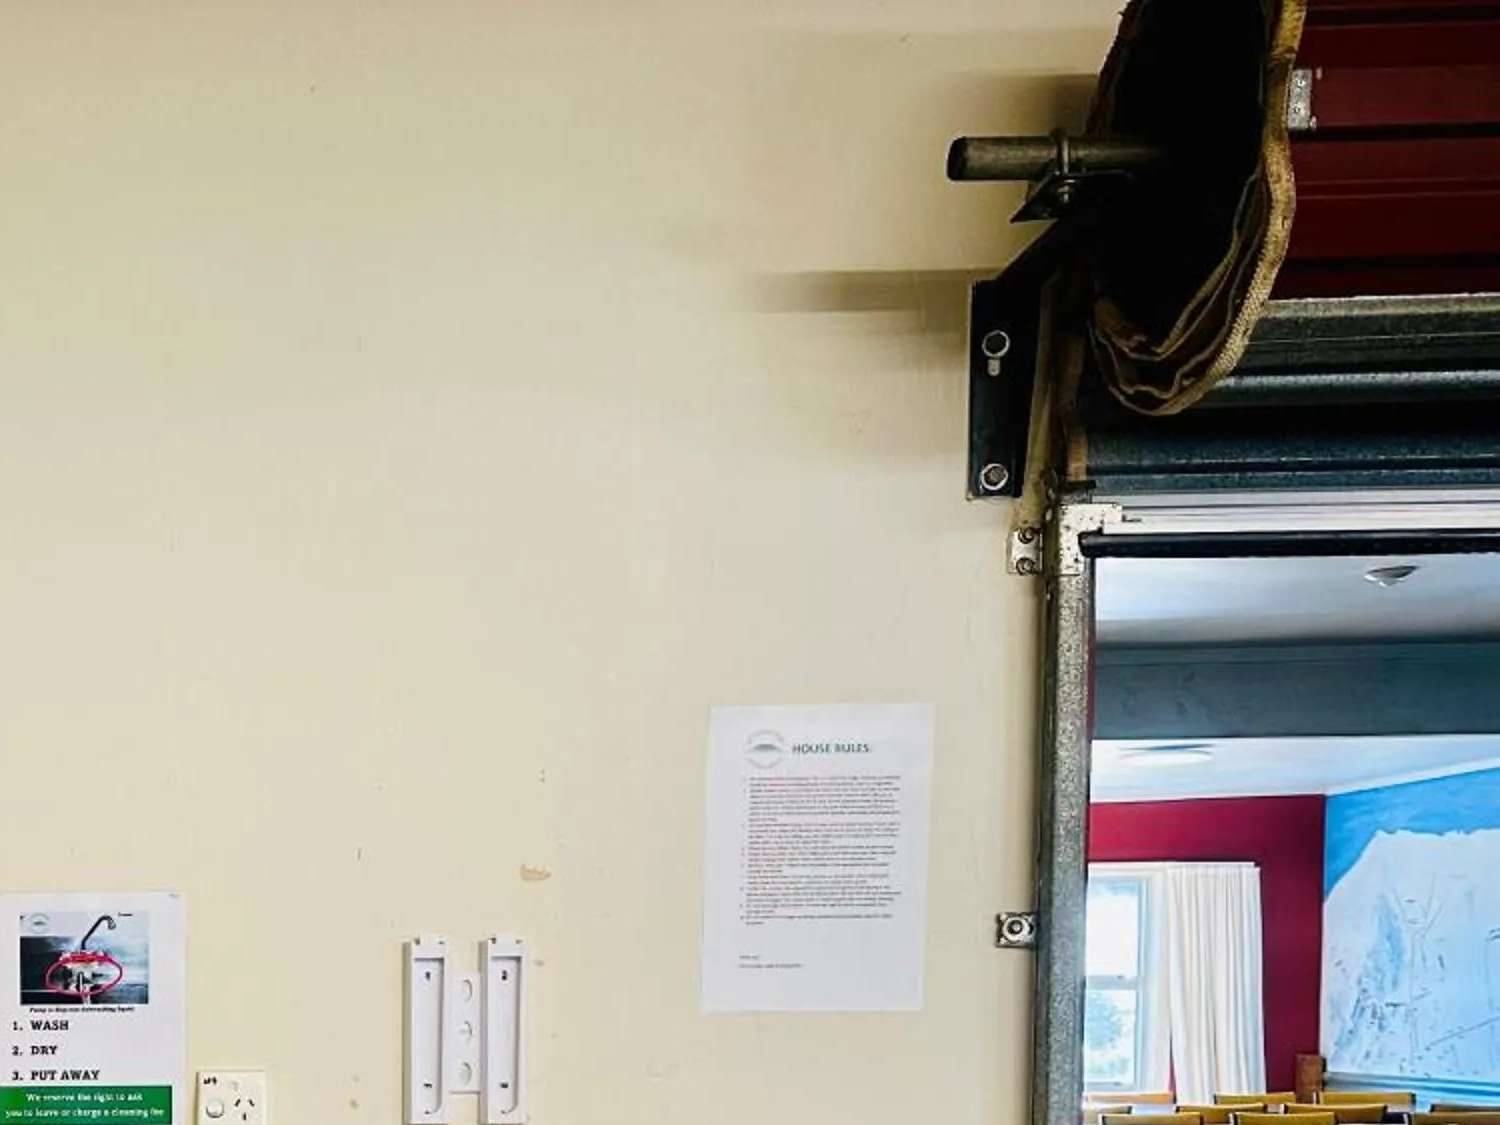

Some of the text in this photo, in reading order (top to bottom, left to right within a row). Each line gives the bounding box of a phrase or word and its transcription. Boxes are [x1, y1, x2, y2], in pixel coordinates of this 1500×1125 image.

[792, 743, 869, 754] HOUSE RULES
[12, 1020, 69, 1031] 1. WASH
[11, 1045, 58, 1056] 2. DRY
[11, 1070, 100, 1081] 3. PUT AWAY
[25, 1093, 41, 1101] We
[5, 1109, 23, 1118] you
